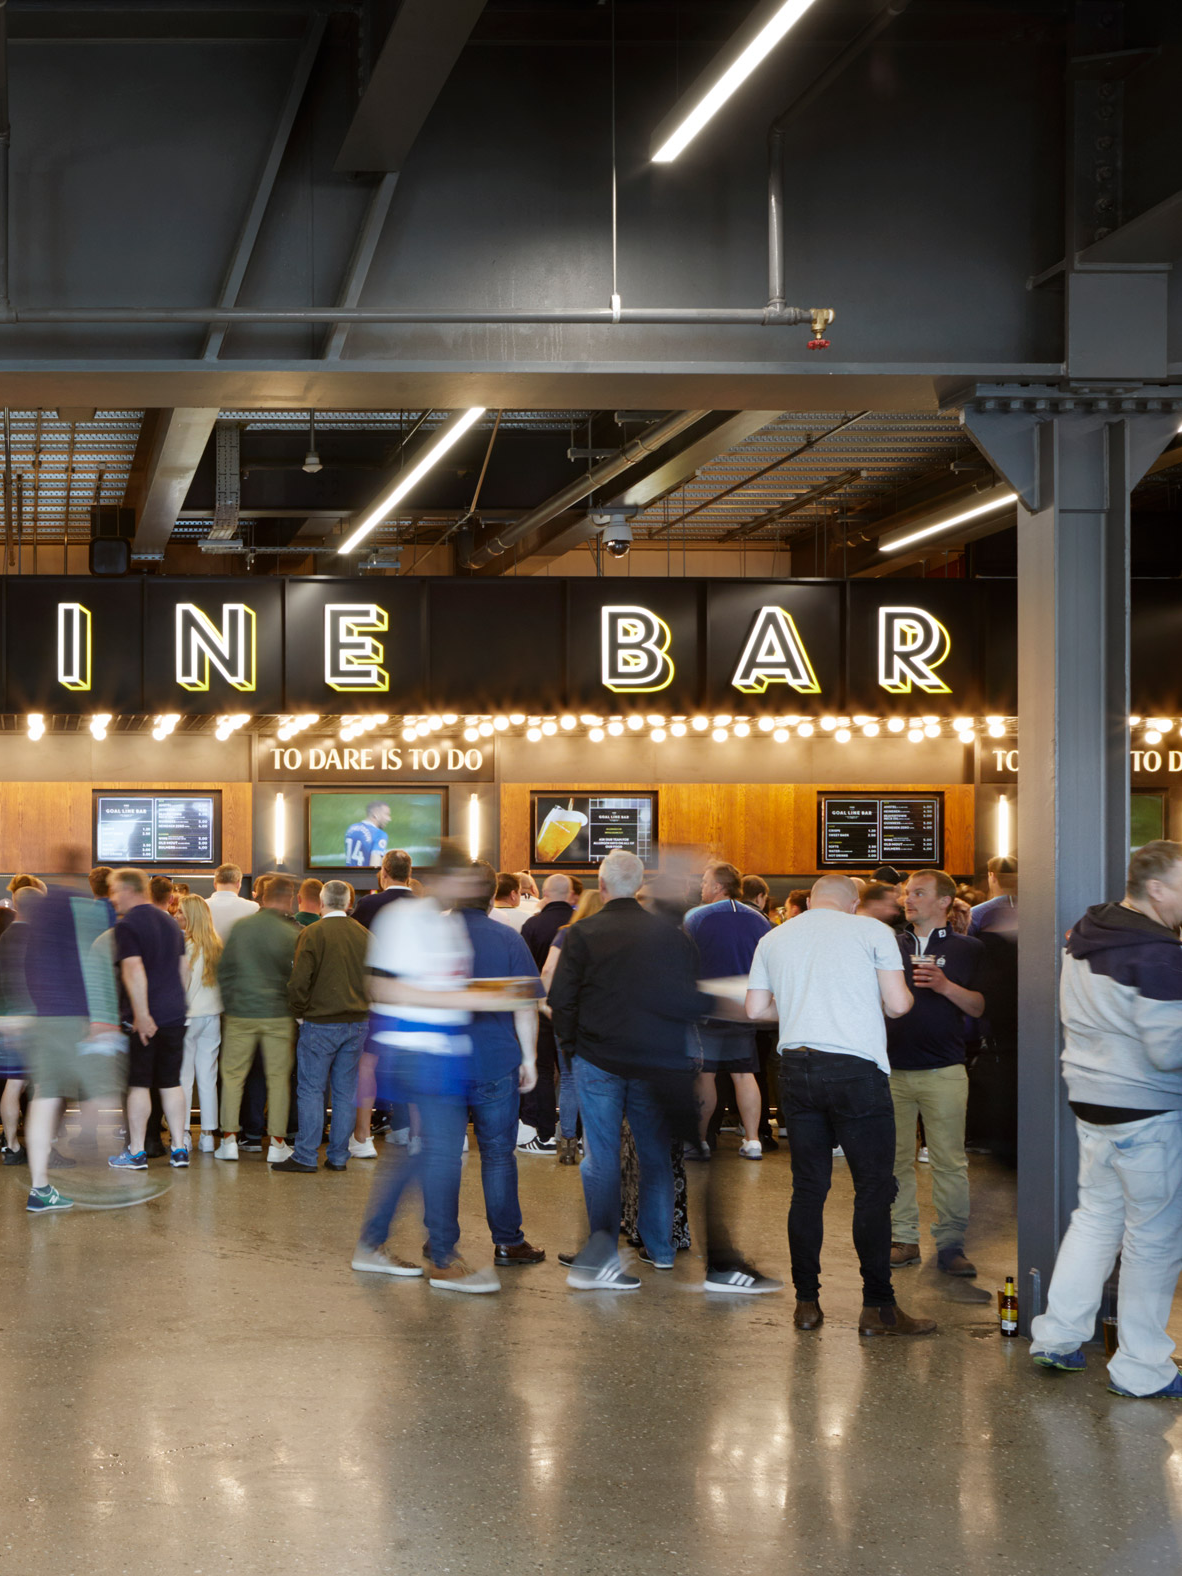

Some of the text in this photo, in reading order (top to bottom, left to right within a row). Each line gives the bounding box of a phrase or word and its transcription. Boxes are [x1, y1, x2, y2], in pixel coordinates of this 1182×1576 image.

[601, 605, 953, 694] BAR
[270, 748, 483, 770] TO DARE IS TO DO
[1130, 750, 1163, 772] TO
[345, 837, 365, 866] 14
